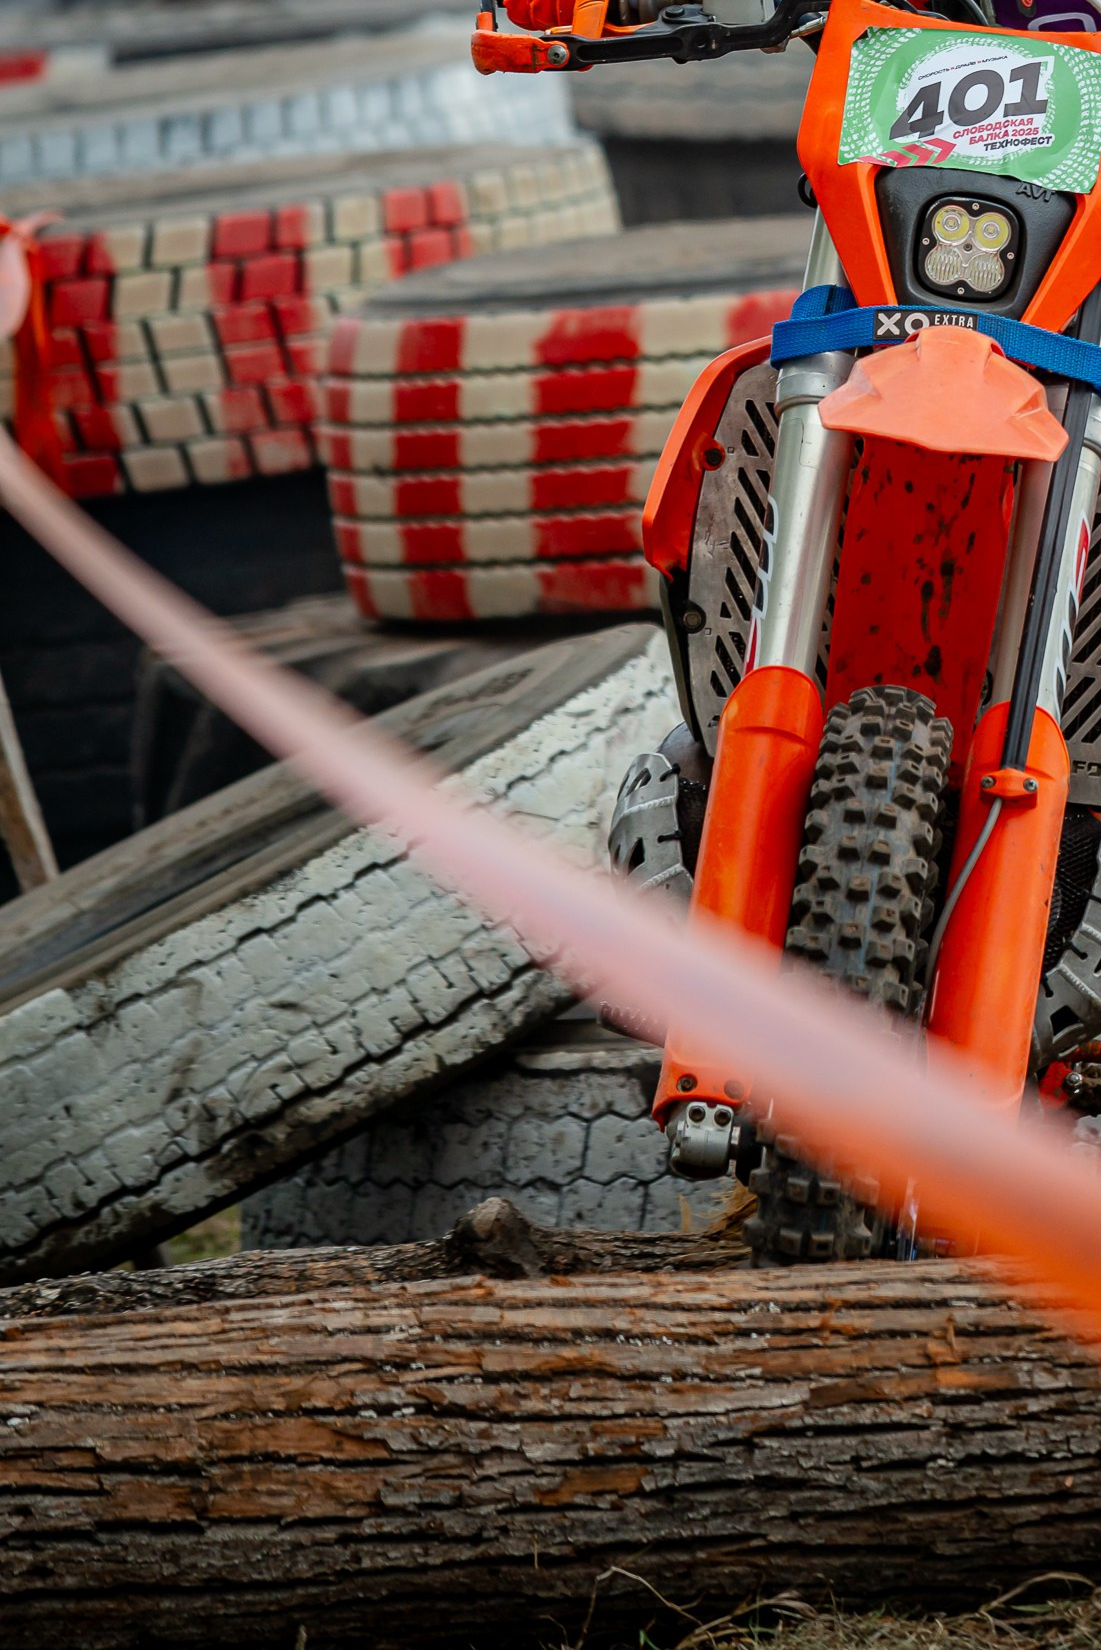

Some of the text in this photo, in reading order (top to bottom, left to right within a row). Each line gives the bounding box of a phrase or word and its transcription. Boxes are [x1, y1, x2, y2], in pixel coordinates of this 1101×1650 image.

[890, 62, 1048, 140] 401
[953, 117, 1034, 140] СЛОБОДСКАЯ
[969, 127, 1039, 145] БАЛКА 2025
[983, 136, 1053, 152] ТЕХНОФЕСТ
[934, 313, 974, 328] EXTRA
